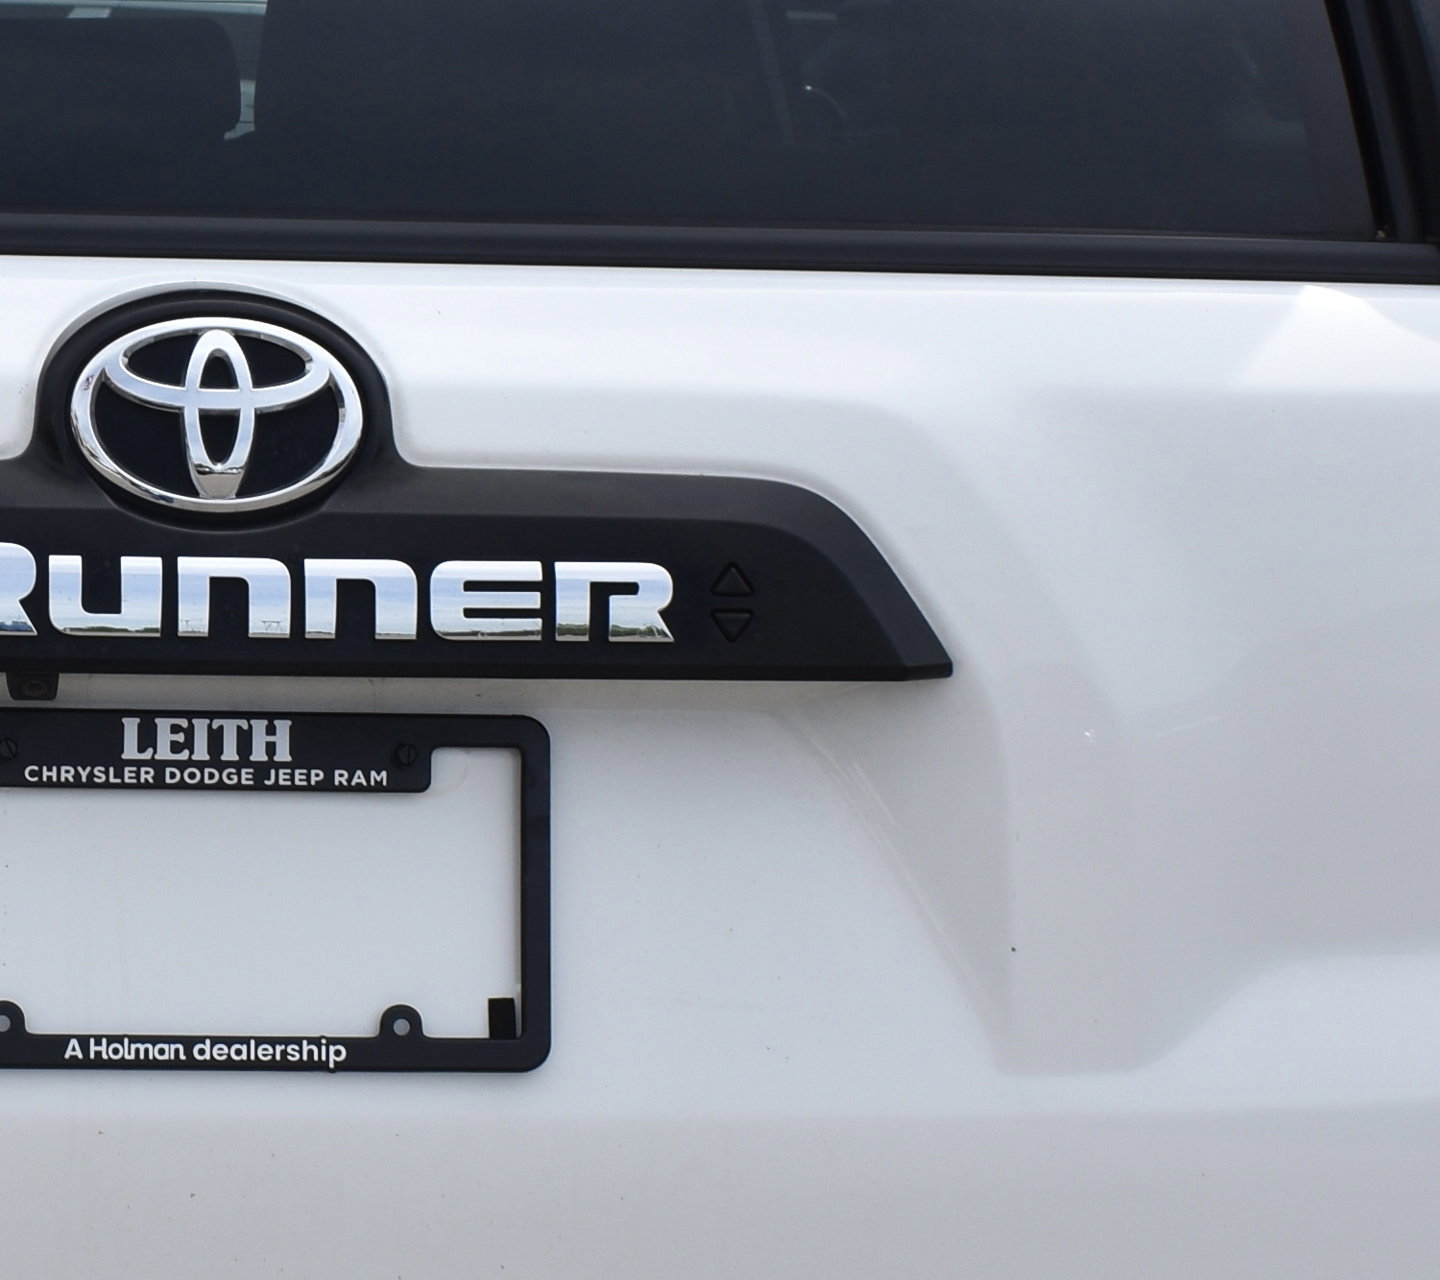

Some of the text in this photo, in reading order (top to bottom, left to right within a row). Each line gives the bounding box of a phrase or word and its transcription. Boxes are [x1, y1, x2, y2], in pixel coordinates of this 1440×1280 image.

[121, 717, 293, 762] LEITH
[23, 764, 388, 787] CHRYSLER DODGE JEEP RAM
[63, 1036, 348, 1069] A Holman dealership
